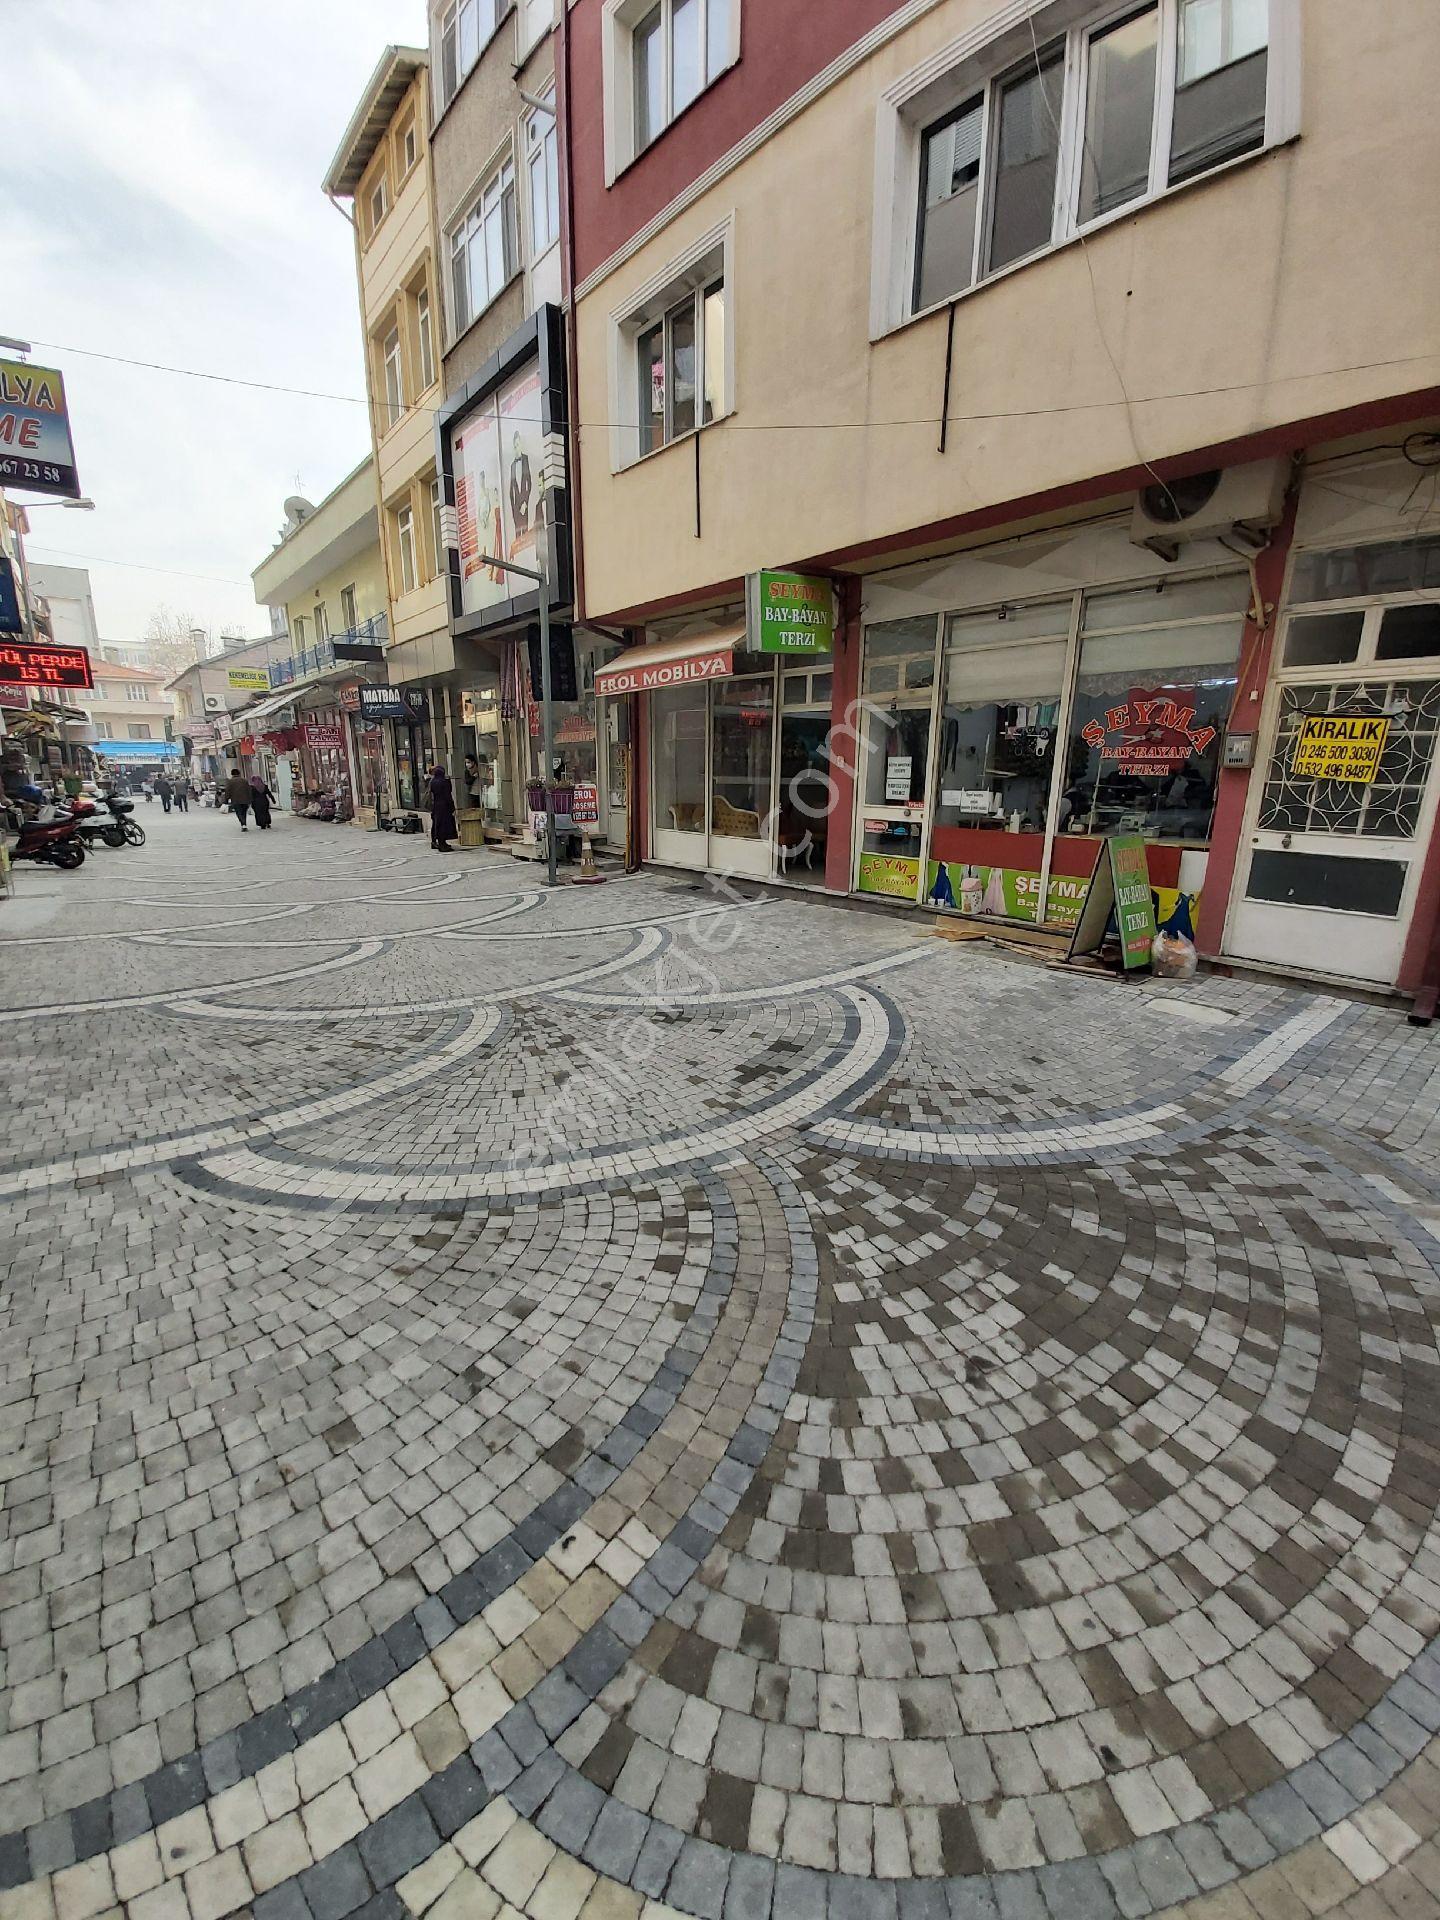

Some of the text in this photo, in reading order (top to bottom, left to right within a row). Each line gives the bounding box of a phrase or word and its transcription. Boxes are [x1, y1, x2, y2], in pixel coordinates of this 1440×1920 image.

[0, 371, 56, 411] LYA
[0, 458, 60, 483] 67 23 58
[765, 606, 828, 625] BAY-BAYAN
[779, 627, 816, 646] TERZİ
[29, 653, 84, 668] PERDE
[20, 667, 64, 681] 15 TL
[599, 657, 727, 693] EROL MOBİLYA
[362, 688, 401, 704] MATBAA
[1304, 718, 1383, 740] KİRALIK
[1101, 746, 1193, 759] BAY-BAYAN
[1300, 744, 1377, 762] 0 246 500 3030
[1296, 761, 1373, 780] 0 532 496 8487
[574, 790, 594, 800] EROL
[1014, 876, 1090, 899] ŞEYMA
[1047, 902, 1081, 915] Baya
